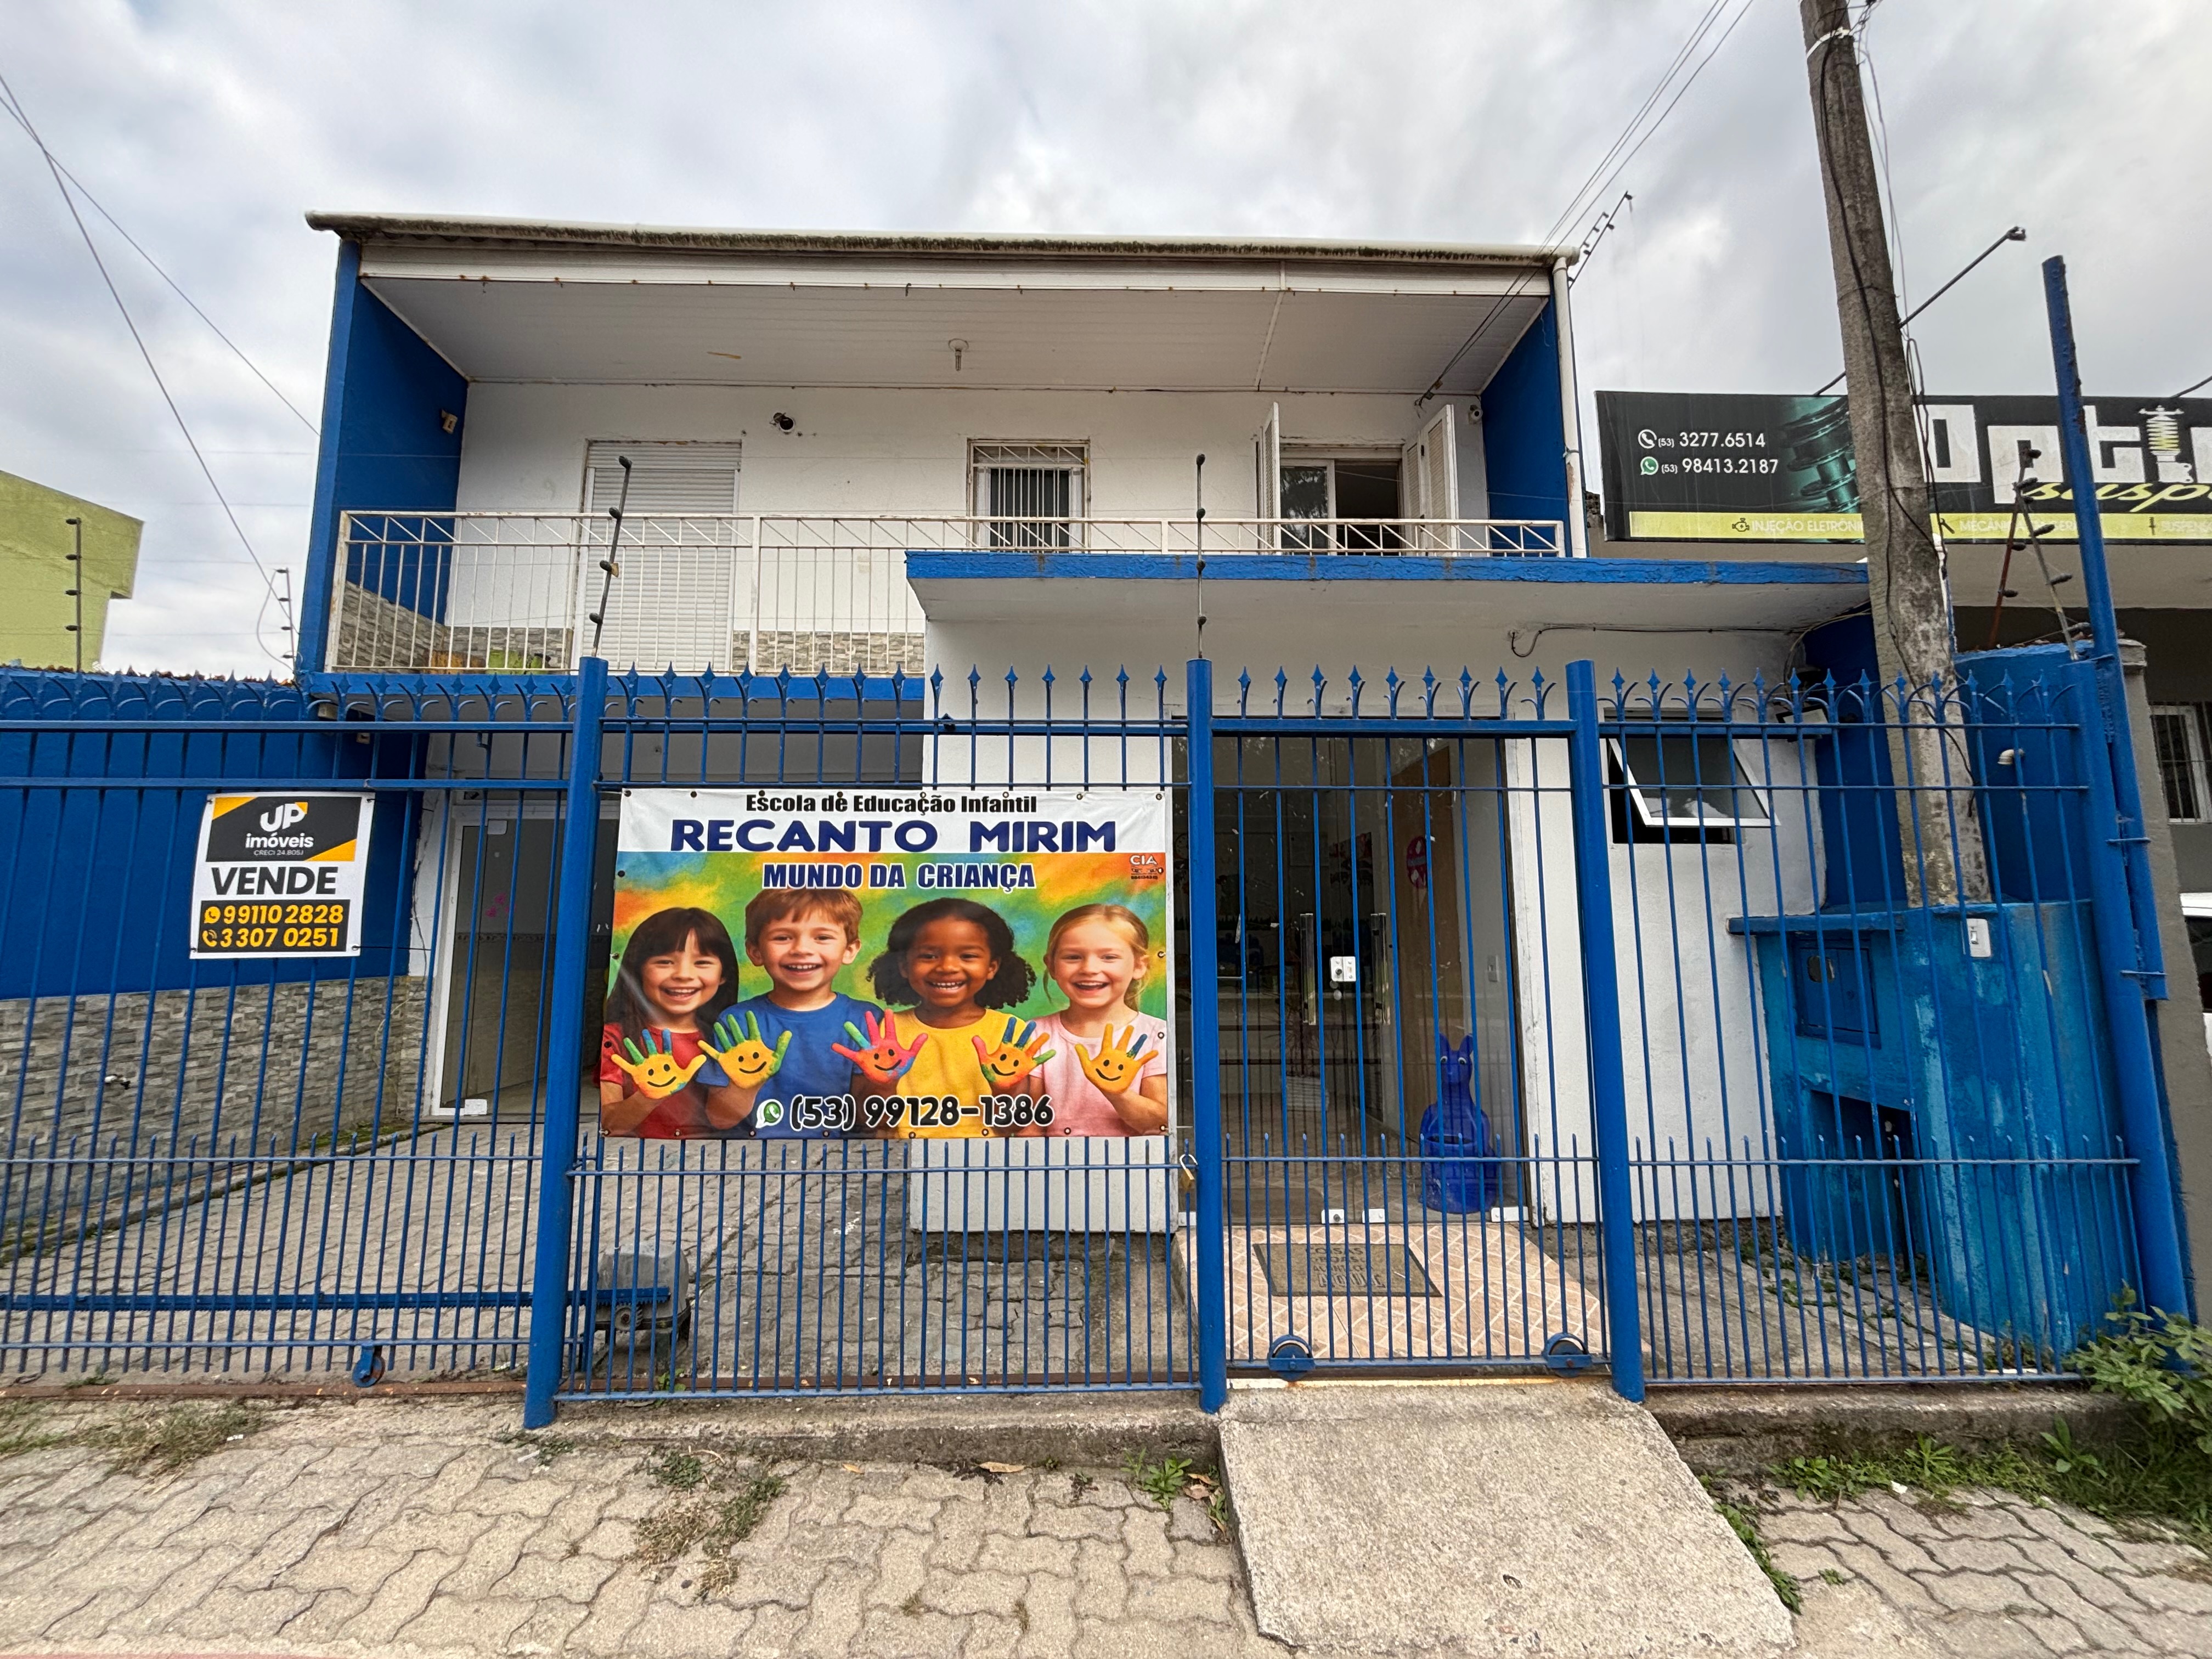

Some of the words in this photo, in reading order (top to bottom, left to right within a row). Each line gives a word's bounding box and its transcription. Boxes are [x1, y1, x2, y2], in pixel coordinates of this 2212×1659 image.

[1658, 438, 1675, 448] (53)
[1679, 432, 1766, 448] 3277.6514
[1661, 464, 1678, 474] (53)
[1682, 458, 1778, 474] 98413.2187
[1752, 518, 1804, 534] INJEÇÃO
[1807, 518, 1863, 532] ELETRÔNI
[746, 794, 816, 812] Escola
[821, 795, 848, 812] de
[854, 795, 956, 816] Educação
[961, 796, 1037, 812] Infantil
[260, 802, 308, 832] UP
[245, 832, 314, 848] imóveis
[670, 819, 938, 853] RECANTO
[969, 821, 1116, 853] MIRIM
[1130, 855, 1158, 865] CIA
[211, 866, 338, 895] VENDE
[763, 863, 864, 889] MUNDO
[869, 864, 906, 889] DA
[917, 864, 1036, 893] CRIANÇA
[223, 905, 283, 924] 99110
[284, 905, 343, 924] 2828
[221, 928, 278, 948] 3307
[283, 928, 338, 947] 0251
[791, 1095, 855, 1130] (53)
[864, 1095, 1053, 1127] 99128-1386
